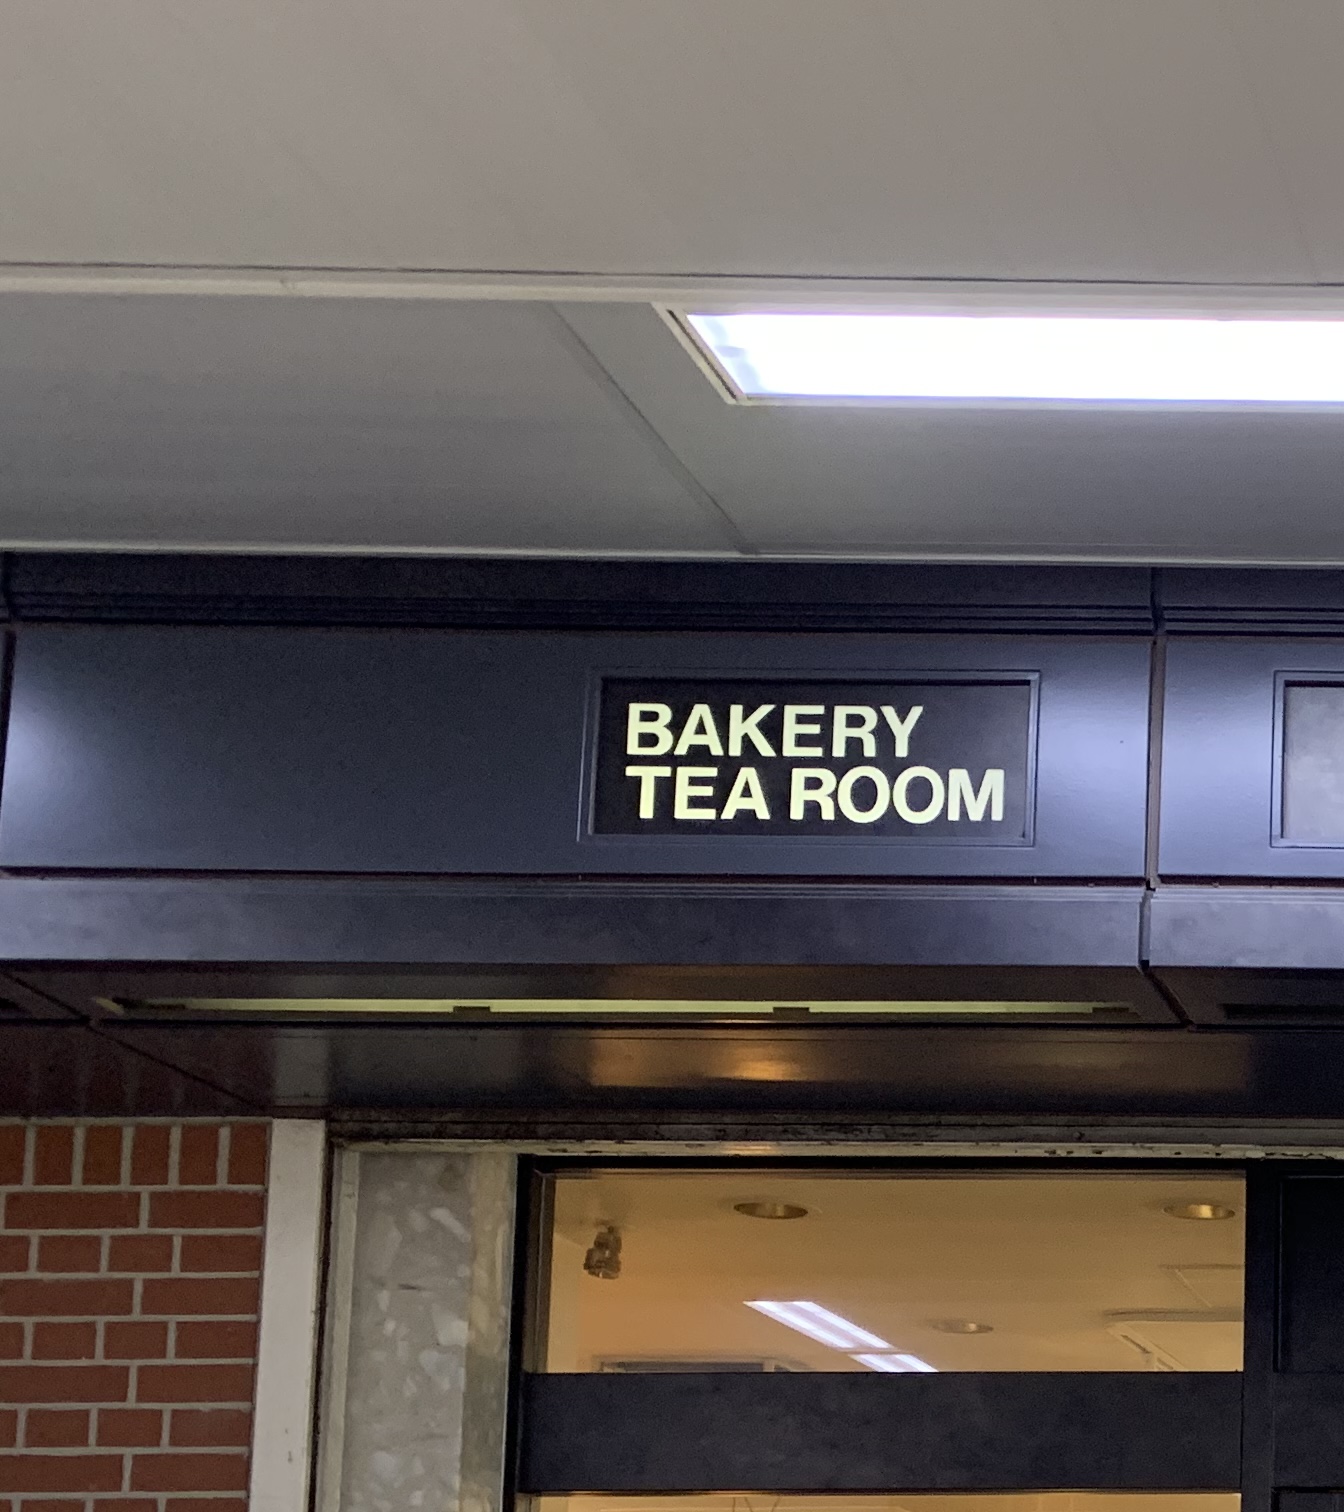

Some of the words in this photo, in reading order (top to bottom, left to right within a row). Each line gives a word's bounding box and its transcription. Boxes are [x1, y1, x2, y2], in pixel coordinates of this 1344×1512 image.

[625, 703, 924, 758] BAKERY
[624, 766, 770, 821] TEA
[788, 766, 1006, 823] ROOM
